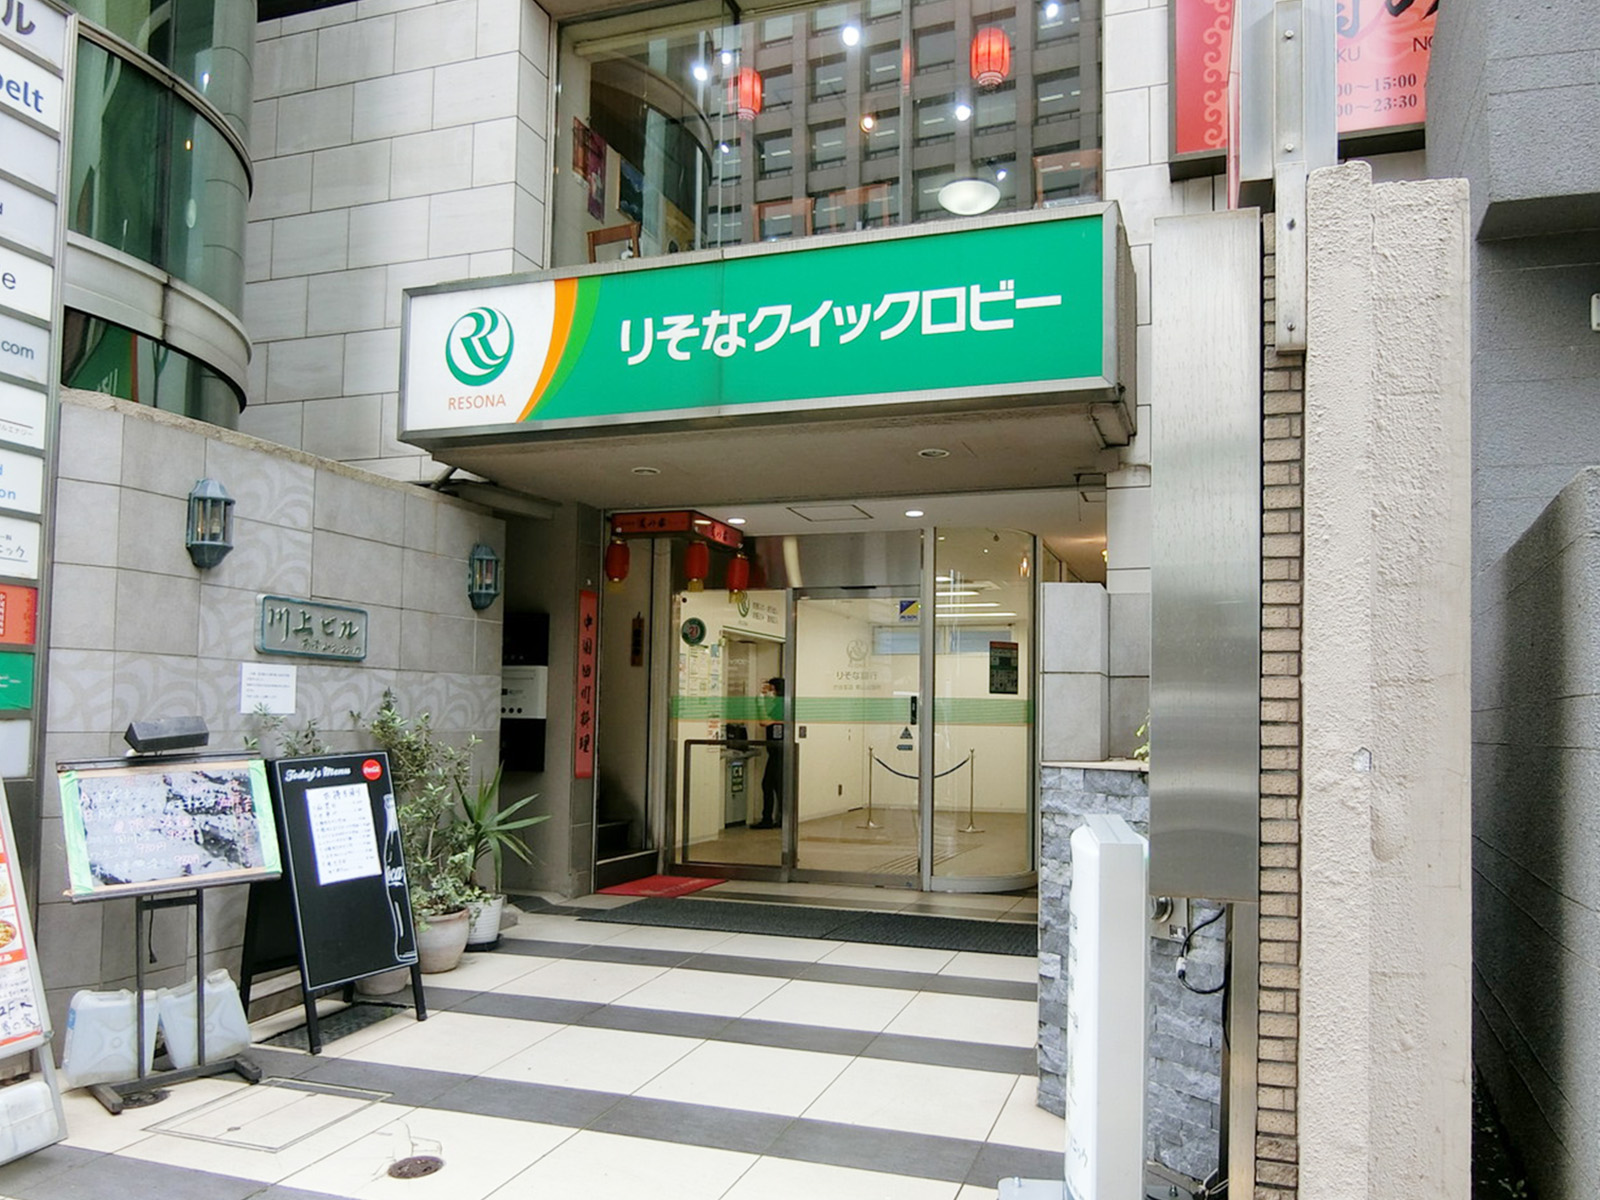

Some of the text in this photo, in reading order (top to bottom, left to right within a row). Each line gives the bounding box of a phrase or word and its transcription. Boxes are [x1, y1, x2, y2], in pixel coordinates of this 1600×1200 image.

[621, 279, 1062, 366] りそなクイックロビー
[448, 394, 507, 411] RESONA
[267, 606, 360, 643] 川上ビル
[284, 765, 351, 783] Today's Menu
